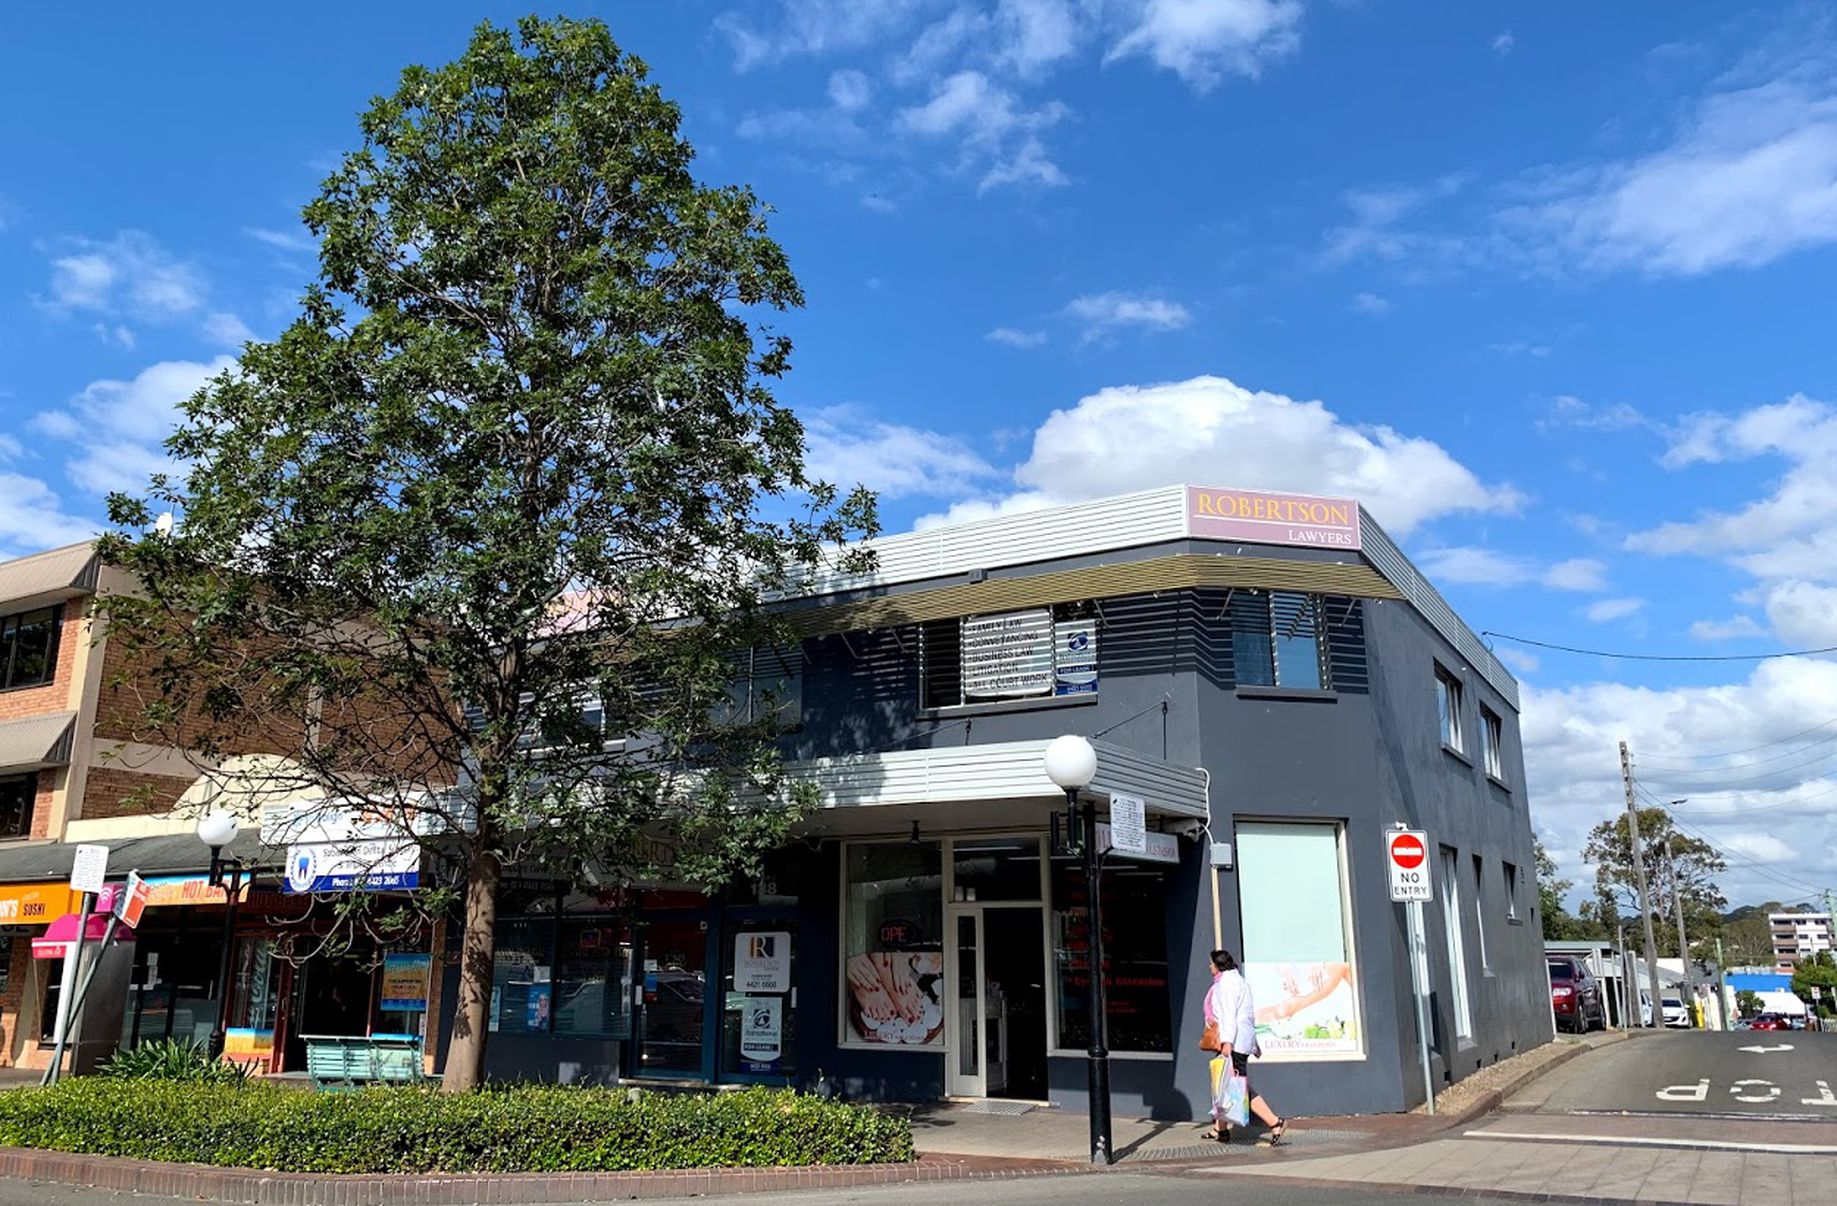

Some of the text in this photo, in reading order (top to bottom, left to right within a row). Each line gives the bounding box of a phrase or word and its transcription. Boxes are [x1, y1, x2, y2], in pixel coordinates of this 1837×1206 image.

[1196, 493, 1349, 526] ROBERTSON
[1288, 529, 1352, 545] LAWYERS
[972, 647, 1014, 662] BUSINESS
[1022, 673, 1049, 686] WORK
[1401, 872, 1419, 883] NO
[181, 880, 205, 899] HOT
[1394, 886, 1427, 895] ENTRY
